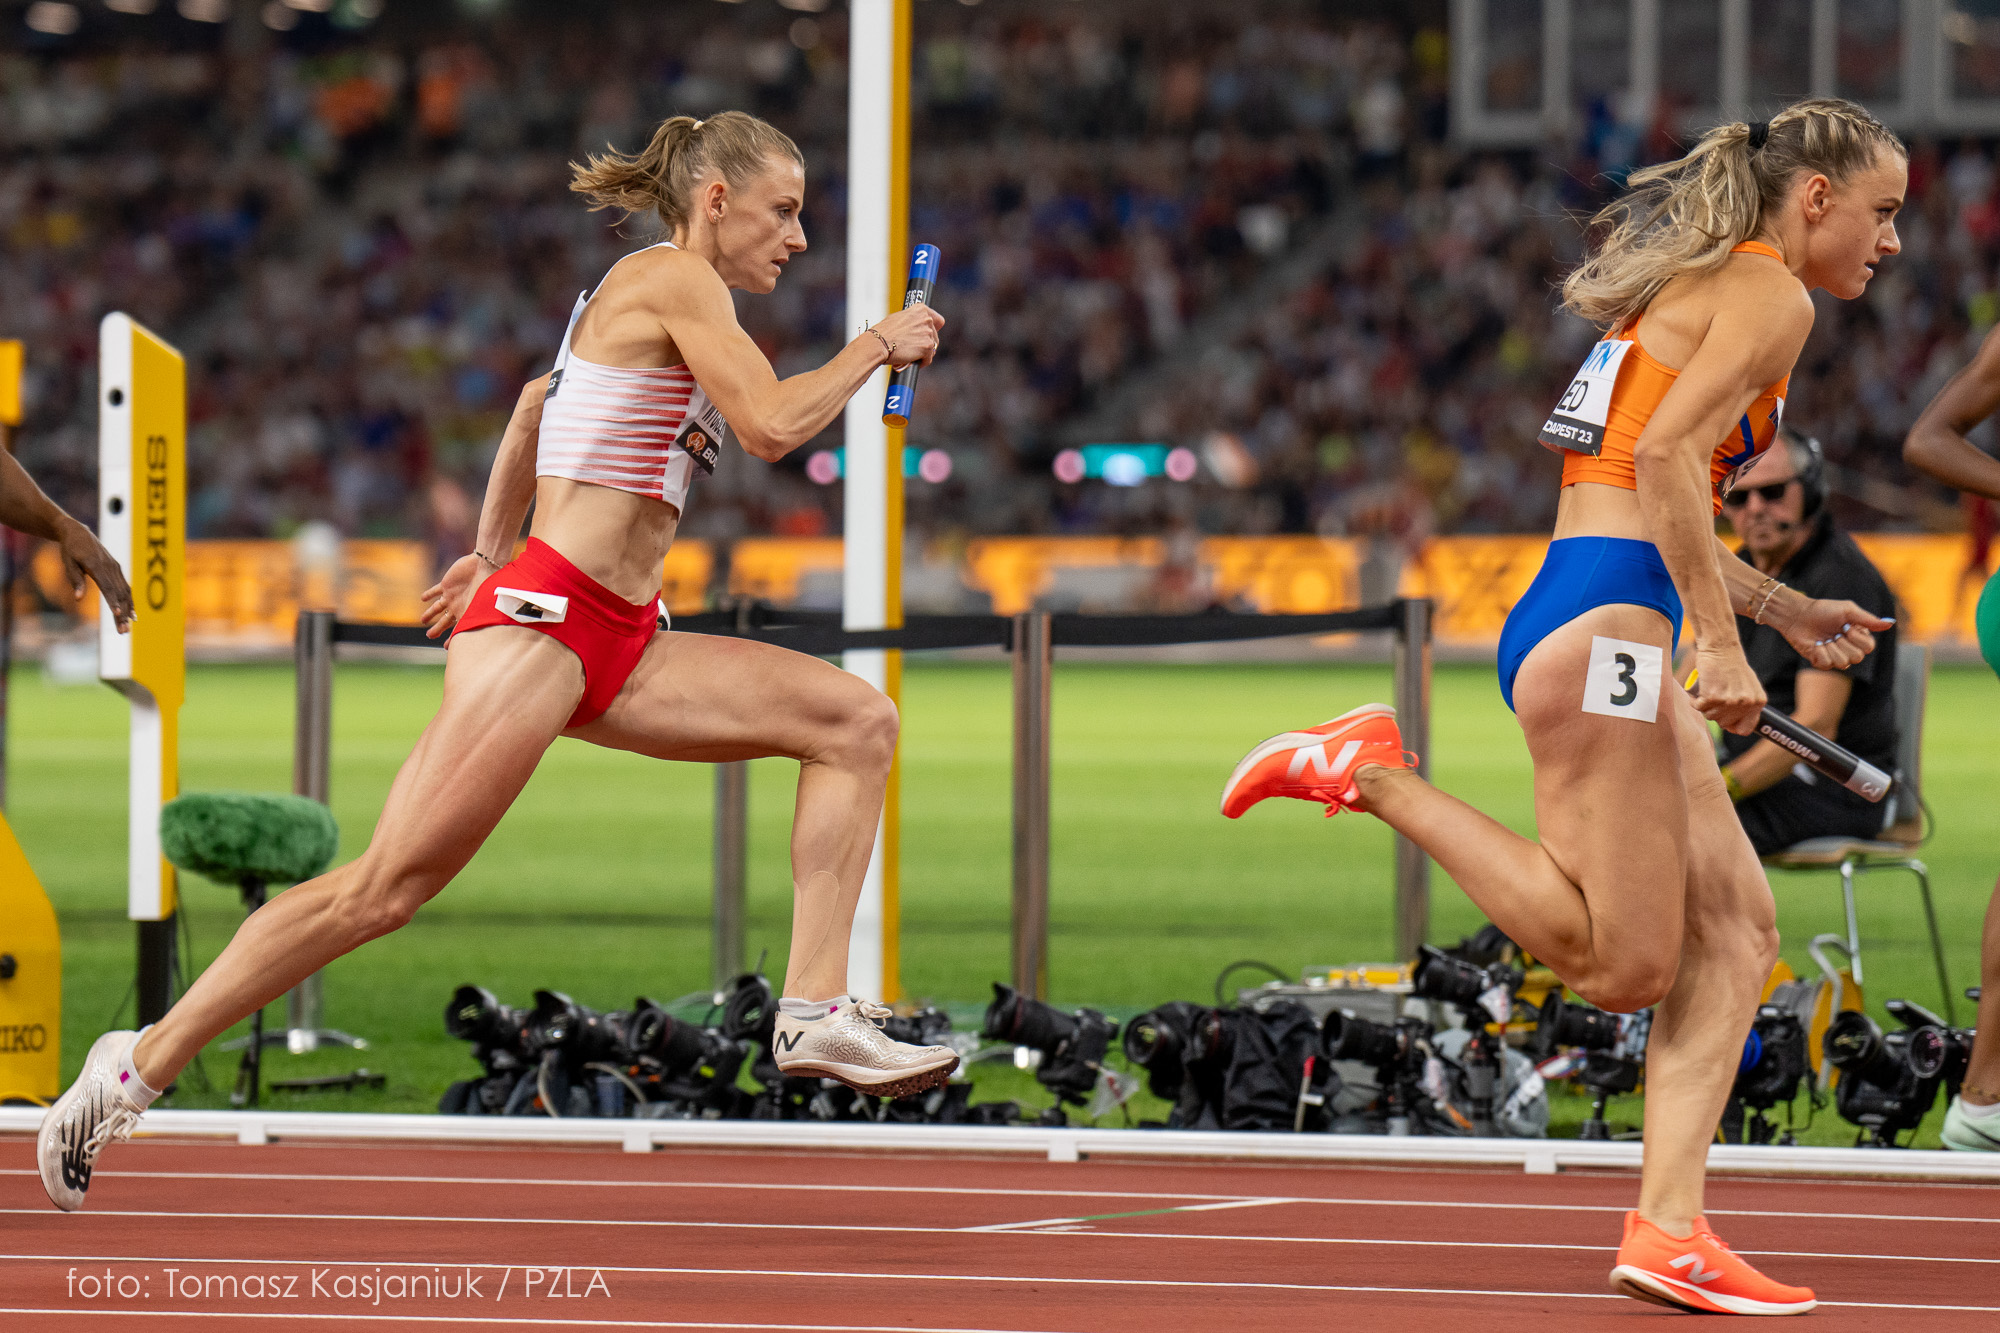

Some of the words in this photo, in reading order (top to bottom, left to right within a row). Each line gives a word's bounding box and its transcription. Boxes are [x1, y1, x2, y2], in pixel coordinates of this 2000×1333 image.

[914, 250, 928, 264] 2
[887, 395, 900, 409] 2
[1577, 429, 1593, 445] 23
[147, 434, 167, 611] SEIKO
[1609, 652, 1638, 707] 3
[1760, 724, 1812, 758] MONDO
[0, 1023, 47, 1053] IKO
